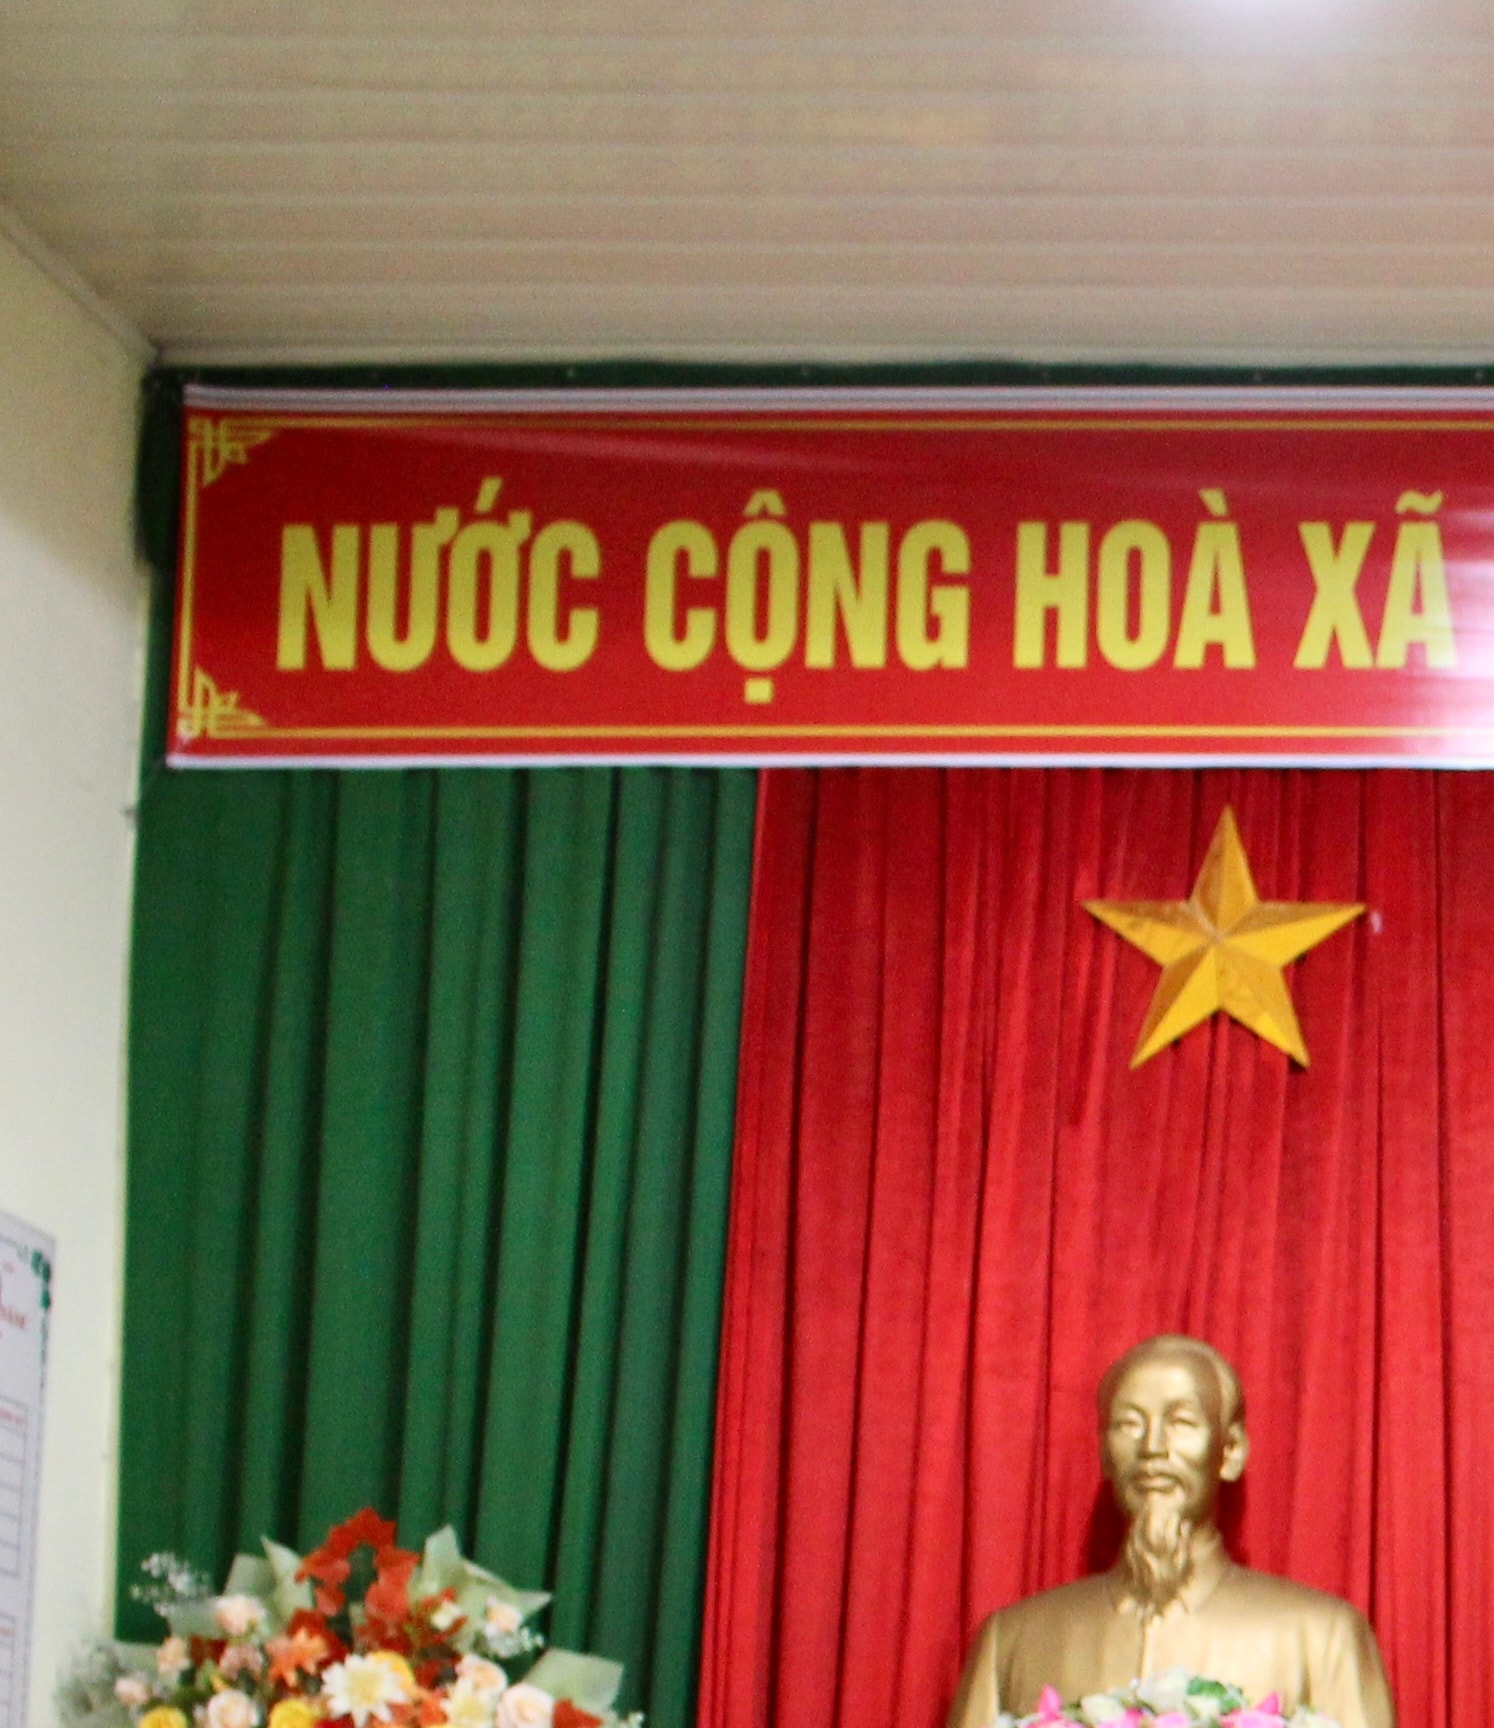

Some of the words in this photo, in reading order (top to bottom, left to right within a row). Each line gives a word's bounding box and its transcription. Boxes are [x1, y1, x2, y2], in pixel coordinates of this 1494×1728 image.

[276, 478, 600, 672] NƯỚC
[644, 490, 970, 704] CỘNG
[1013, 489, 1256, 671] HOÀ
[1293, 490, 1458, 671] XÃ
